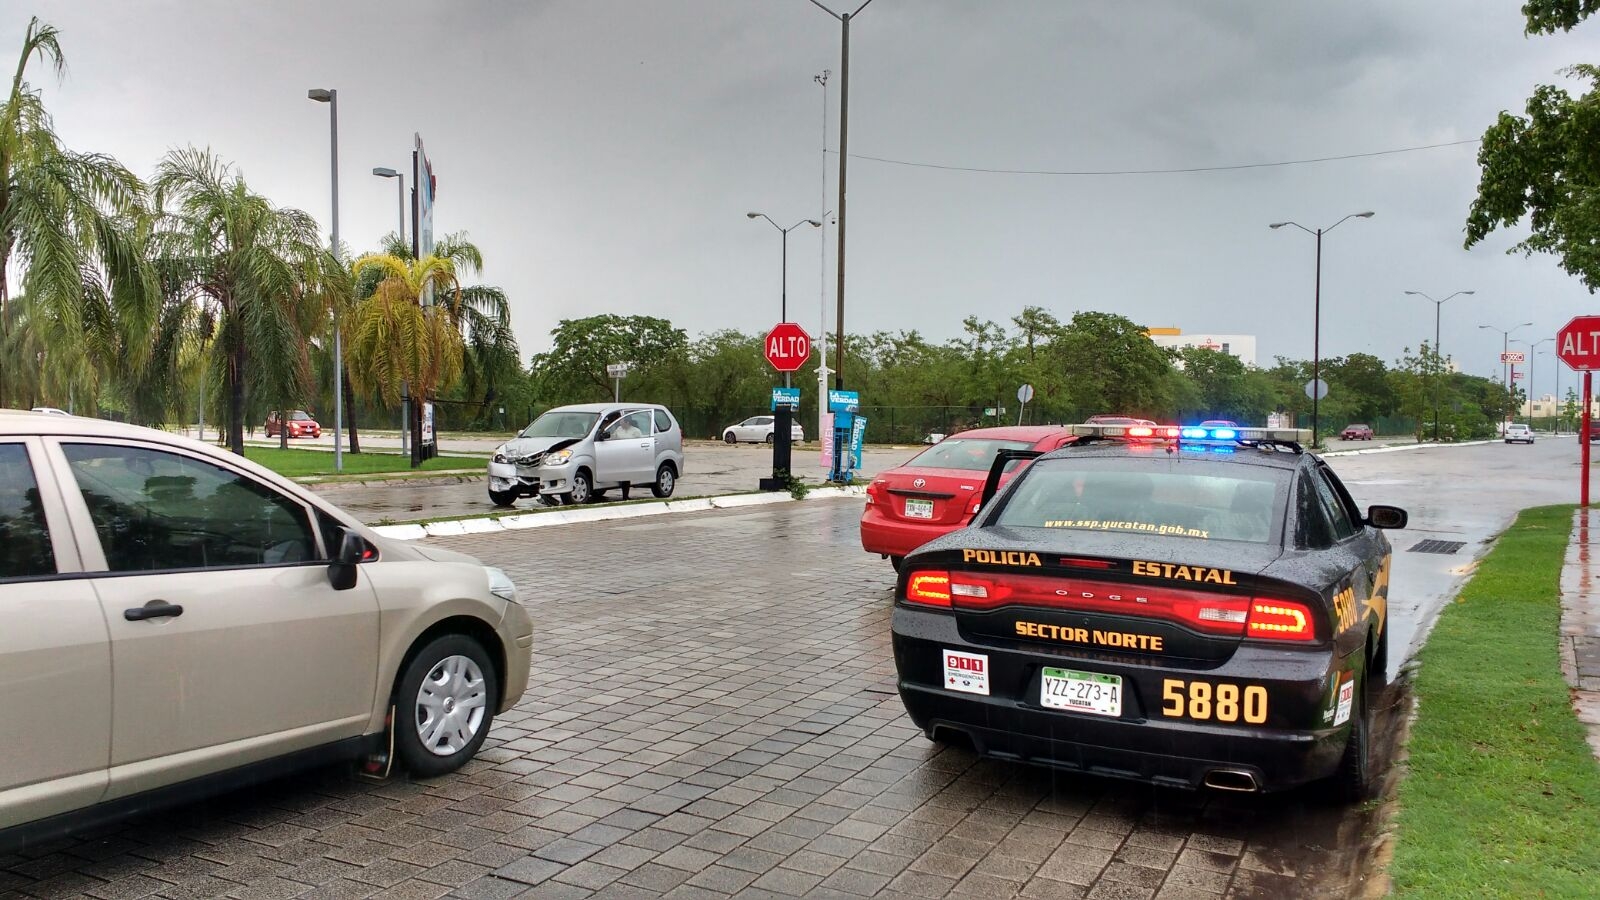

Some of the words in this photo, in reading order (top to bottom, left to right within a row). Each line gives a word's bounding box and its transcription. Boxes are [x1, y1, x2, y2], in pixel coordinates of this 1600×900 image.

[769, 336, 806, 358] ALTO
[1562, 332, 1600, 356] ALT
[852, 418, 860, 450] VERDAD
[1044, 518, 1209, 539] www.ssp.yucatan.gob.mx
[963, 548, 1042, 567] POLICIA
[1132, 561, 1237, 585] ESTATAL
[1333, 587, 1358, 634] 5880
[1016, 620, 1088, 643] SECTOR
[1093, 630, 1163, 651] NORTE
[949, 656, 982, 671] 911
[948, 672, 984, 681] EMERGENCIAS
[1045, 678, 1118, 704] YZZ-273-A
[1069, 698, 1091, 706] YUCATAN
[1162, 678, 1268, 724] 5880
